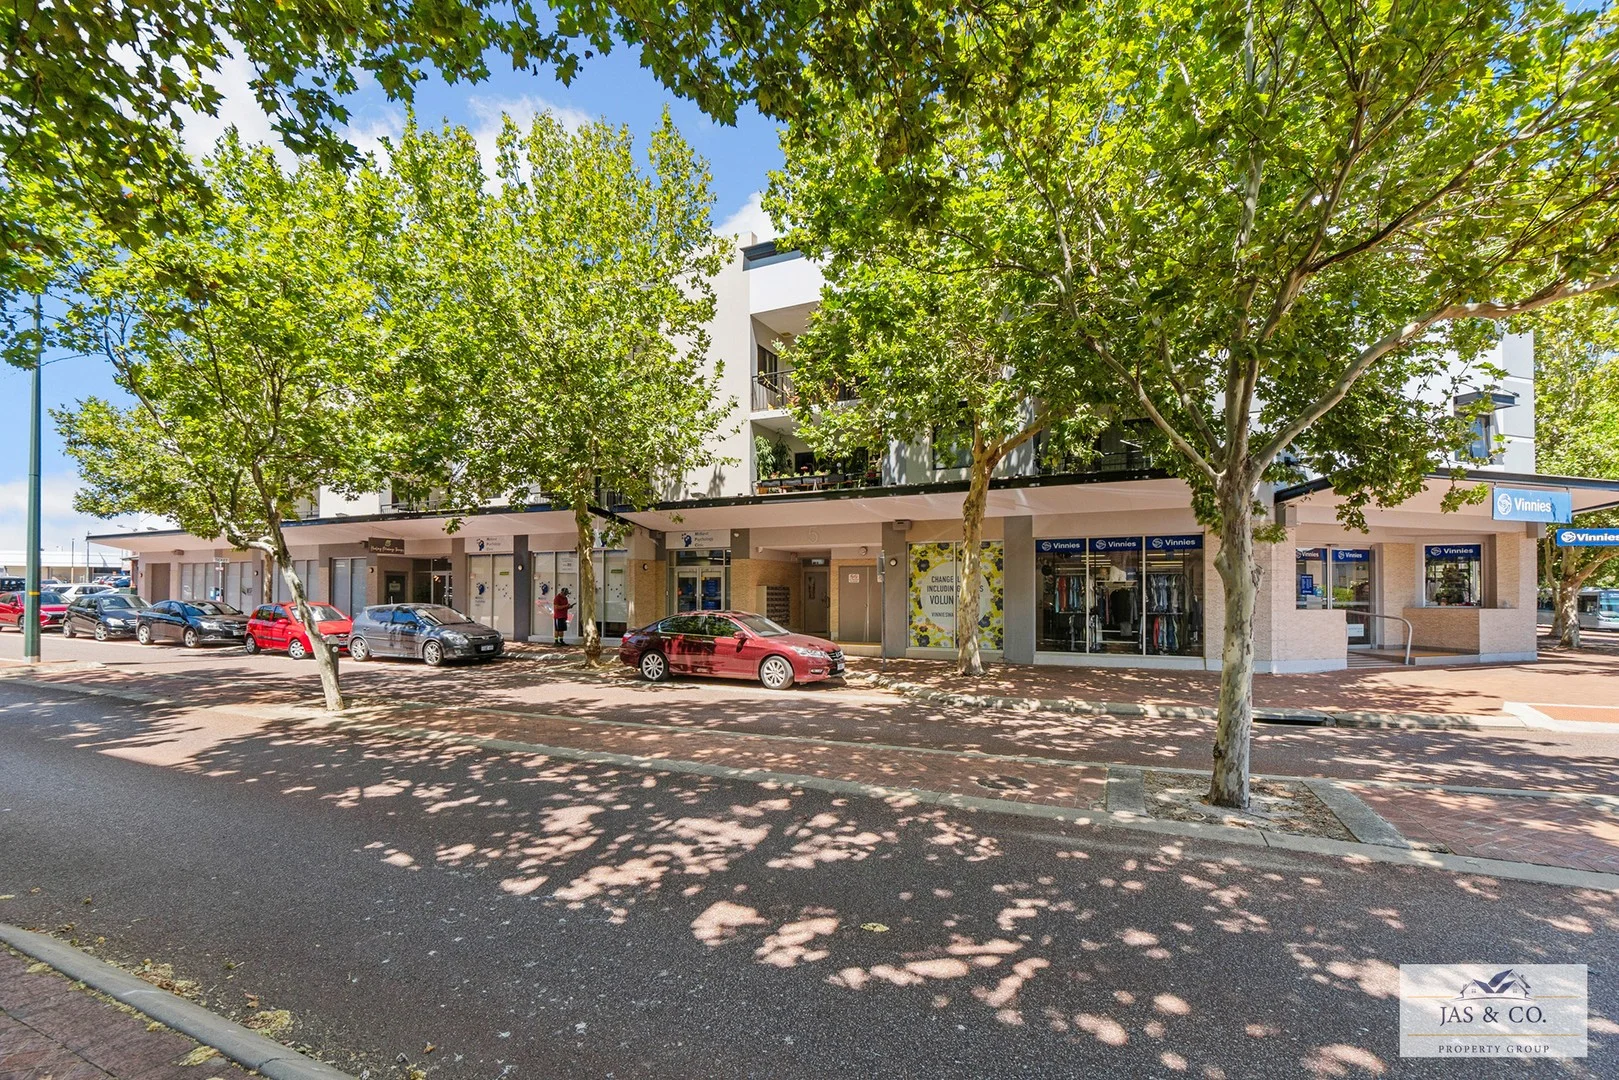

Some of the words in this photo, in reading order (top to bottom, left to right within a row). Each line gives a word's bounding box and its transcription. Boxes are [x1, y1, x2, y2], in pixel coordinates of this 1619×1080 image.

[1514, 497, 1552, 513] Vinnies
[809, 526, 819, 544] 5
[931, 575, 954, 583] CHANGE
[926, 585, 961, 593] INCLUDING
